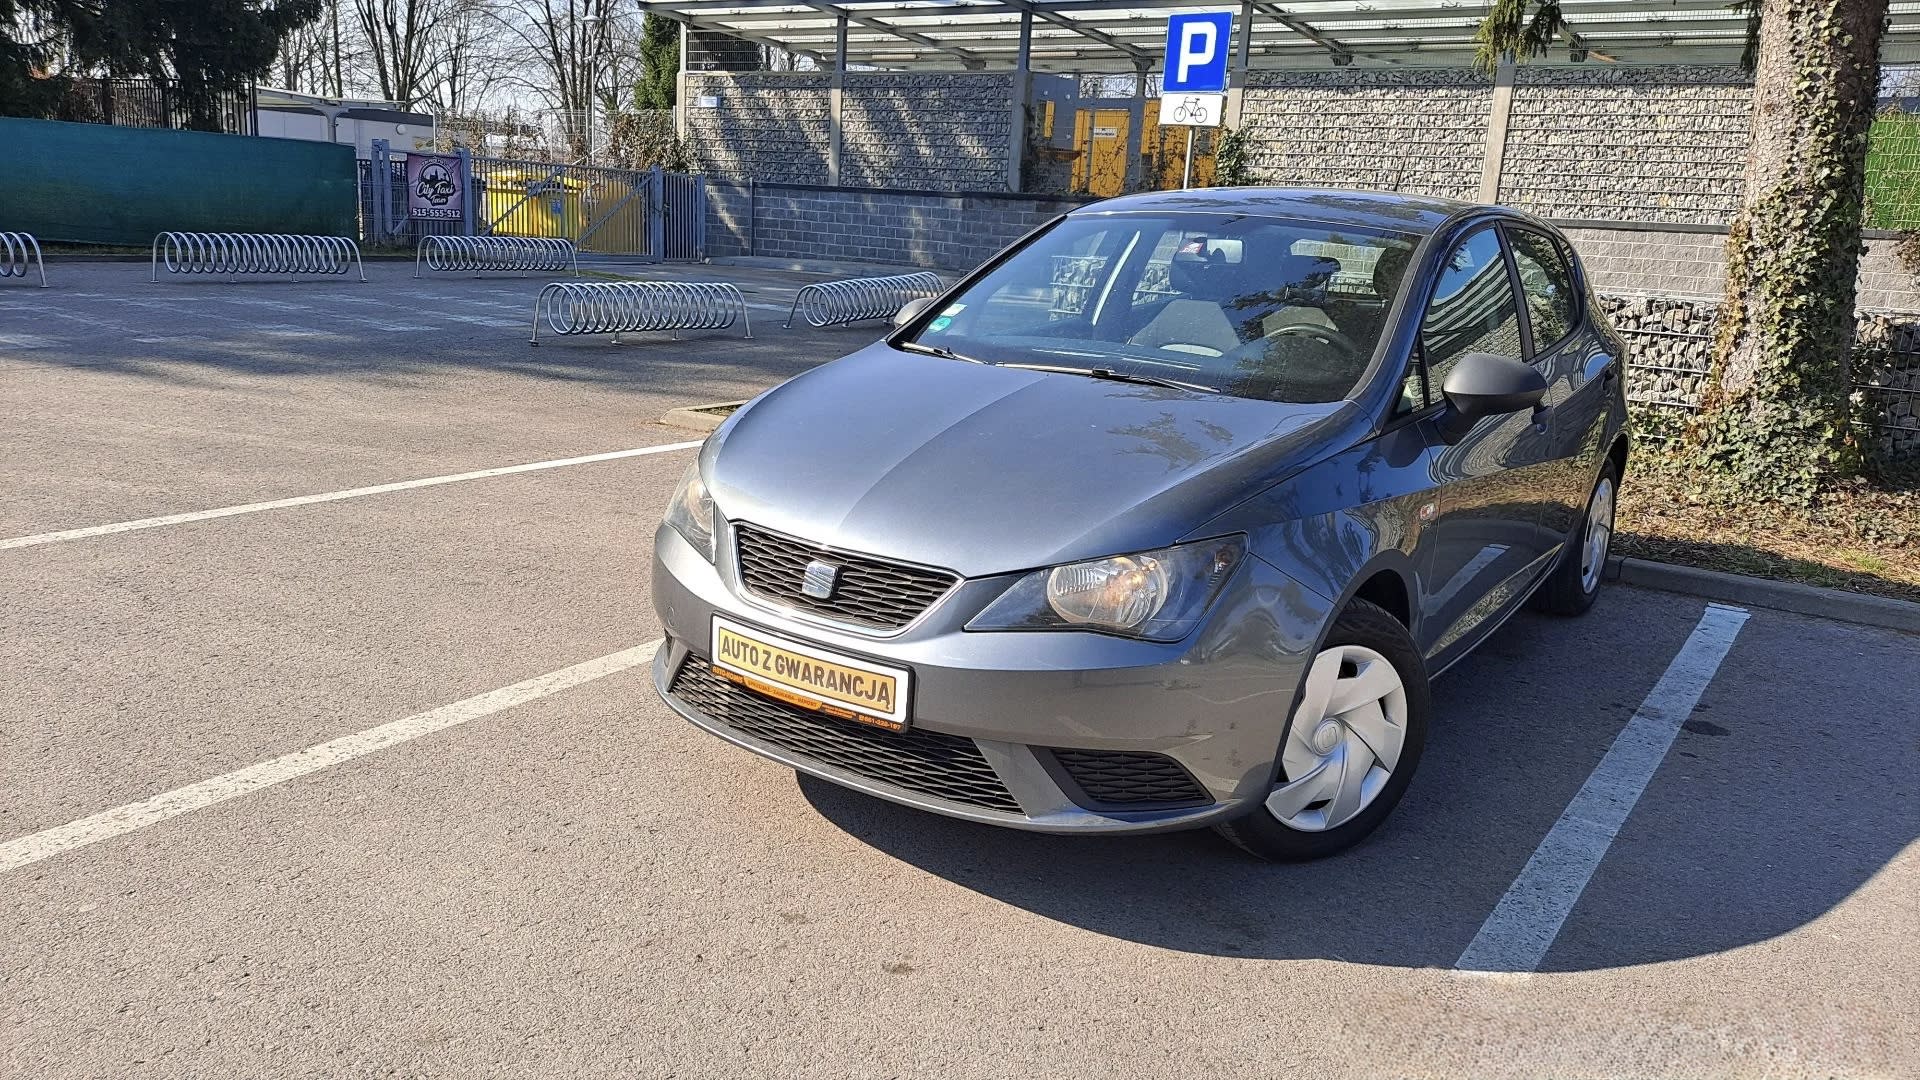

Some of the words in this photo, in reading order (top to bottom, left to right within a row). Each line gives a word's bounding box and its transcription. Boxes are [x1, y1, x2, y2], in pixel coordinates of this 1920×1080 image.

[1177, 22, 1217, 83] P
[416, 181, 434, 198] City
[434, 181, 454, 194] Taxi
[412, 208, 461, 218] 515-555-512
[721, 635, 759, 667] AUTO
[762, 649, 772, 672] Z
[774, 654, 892, 710] GWARANCJĄ
